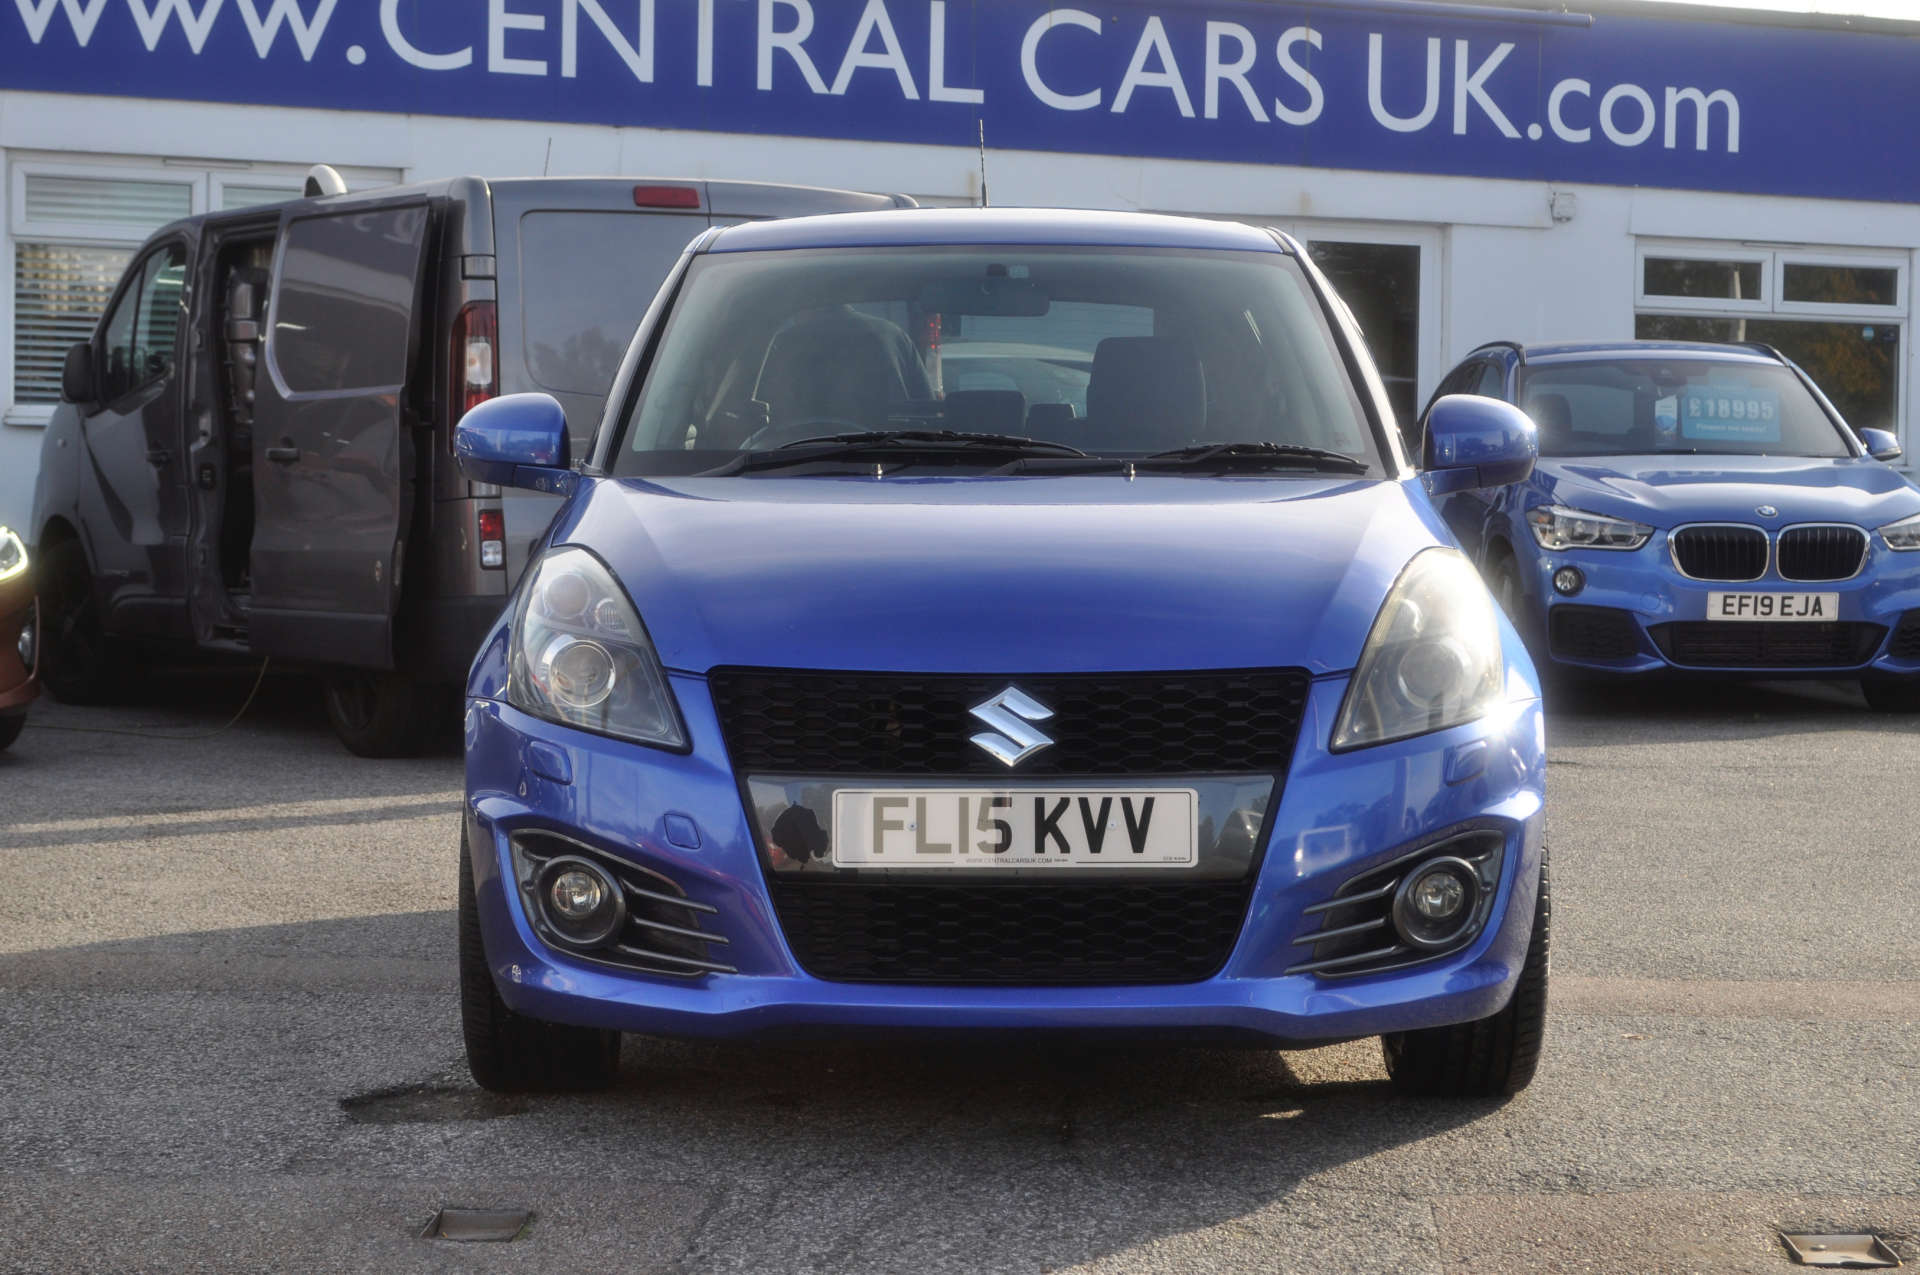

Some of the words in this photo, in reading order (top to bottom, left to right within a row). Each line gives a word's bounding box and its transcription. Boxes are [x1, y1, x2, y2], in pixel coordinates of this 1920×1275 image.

[1021, 8, 1325, 126] CARS
[1368, 33, 1741, 153] UK.com
[1721, 594, 1773, 616] EF19
[1780, 595, 1823, 617] EJA
[873, 796, 1012, 854] FL15
[1034, 796, 1155, 854] KVV
